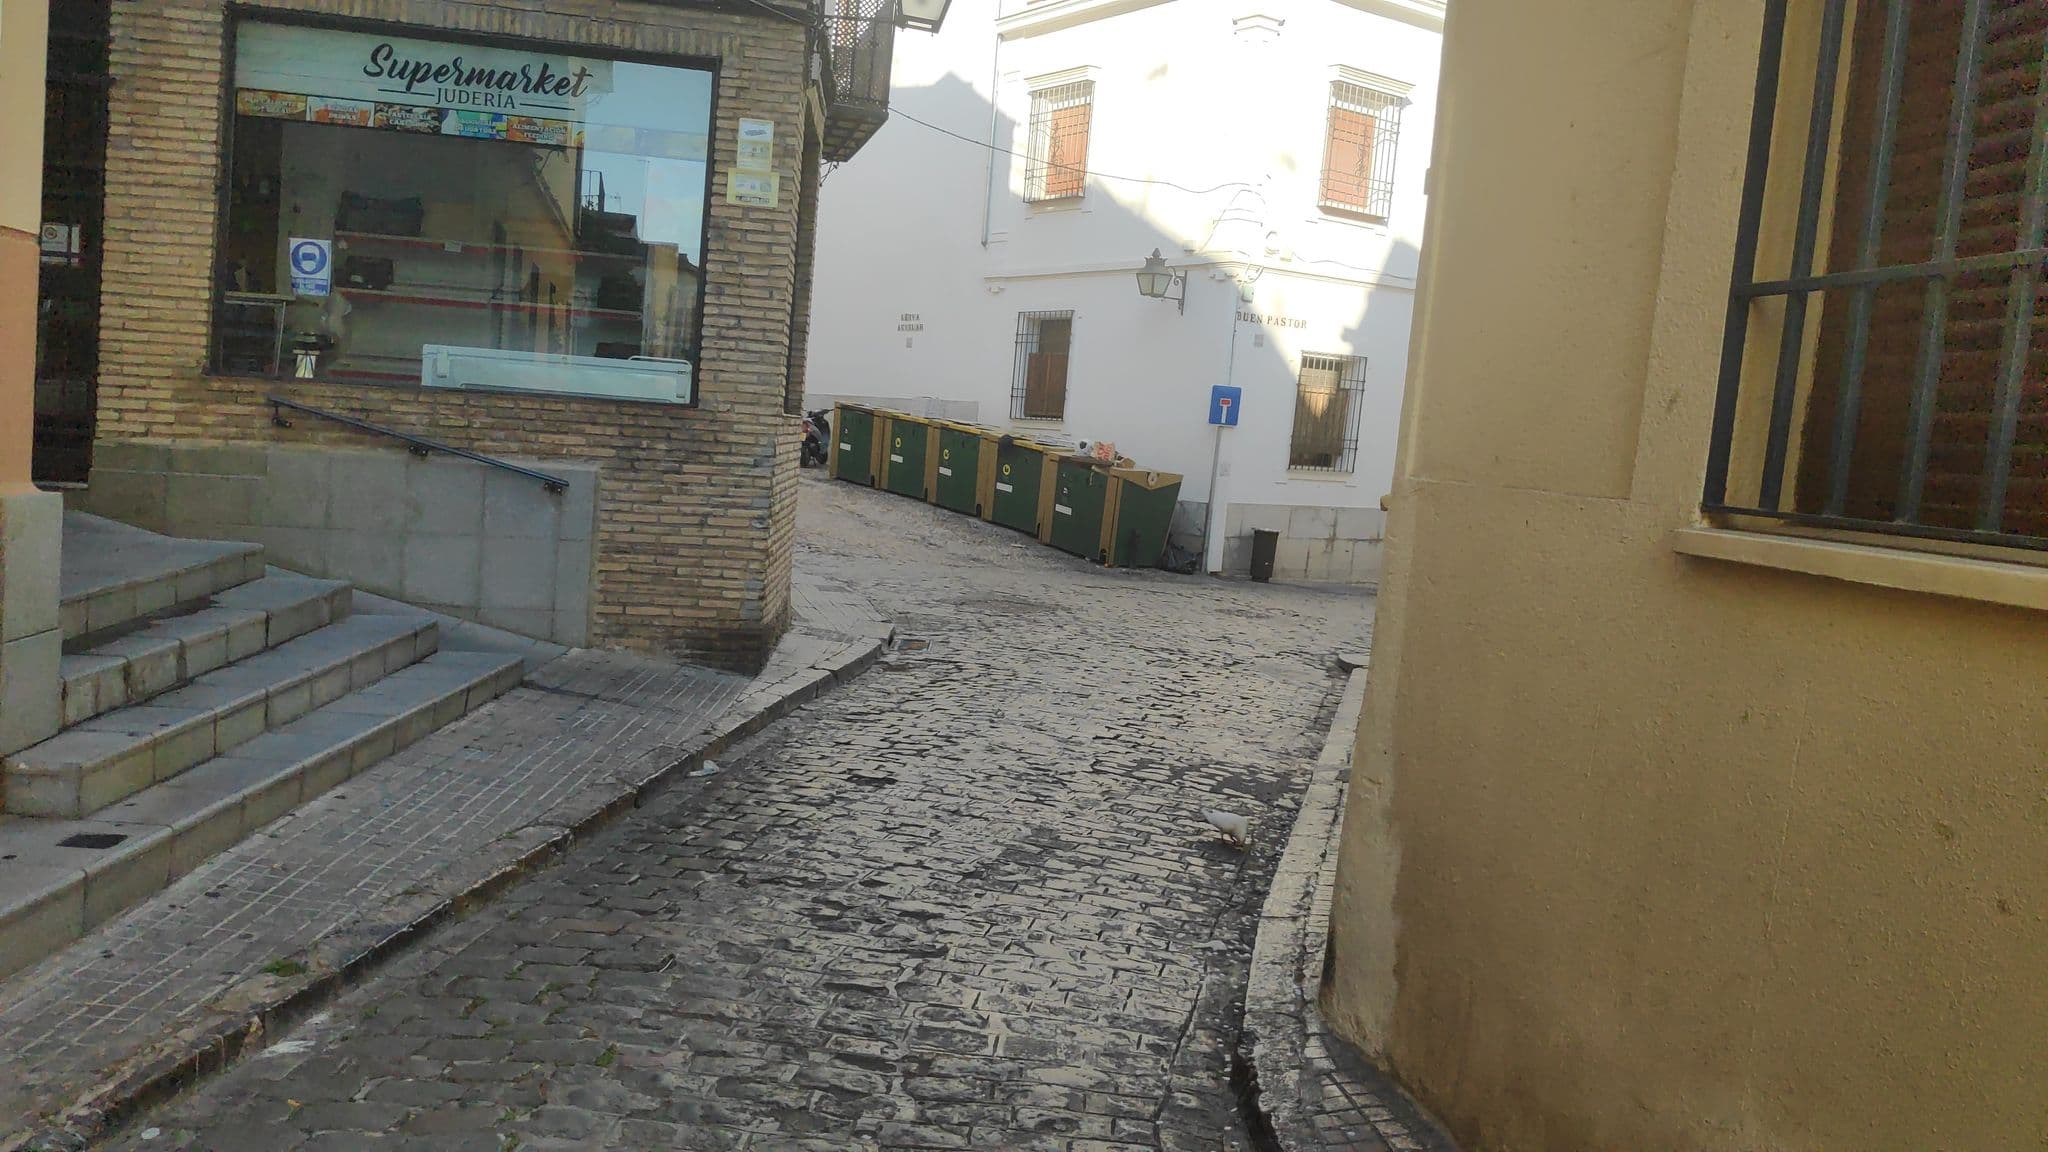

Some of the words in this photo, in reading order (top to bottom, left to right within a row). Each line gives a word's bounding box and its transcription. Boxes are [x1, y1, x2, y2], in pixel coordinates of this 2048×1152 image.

[363, 43, 594, 98] Supermarket
[435, 87, 516, 109] JUDERÍA
[1236, 311, 1263, 324] BUEN
[1267, 315, 1307, 328] PASTOR
